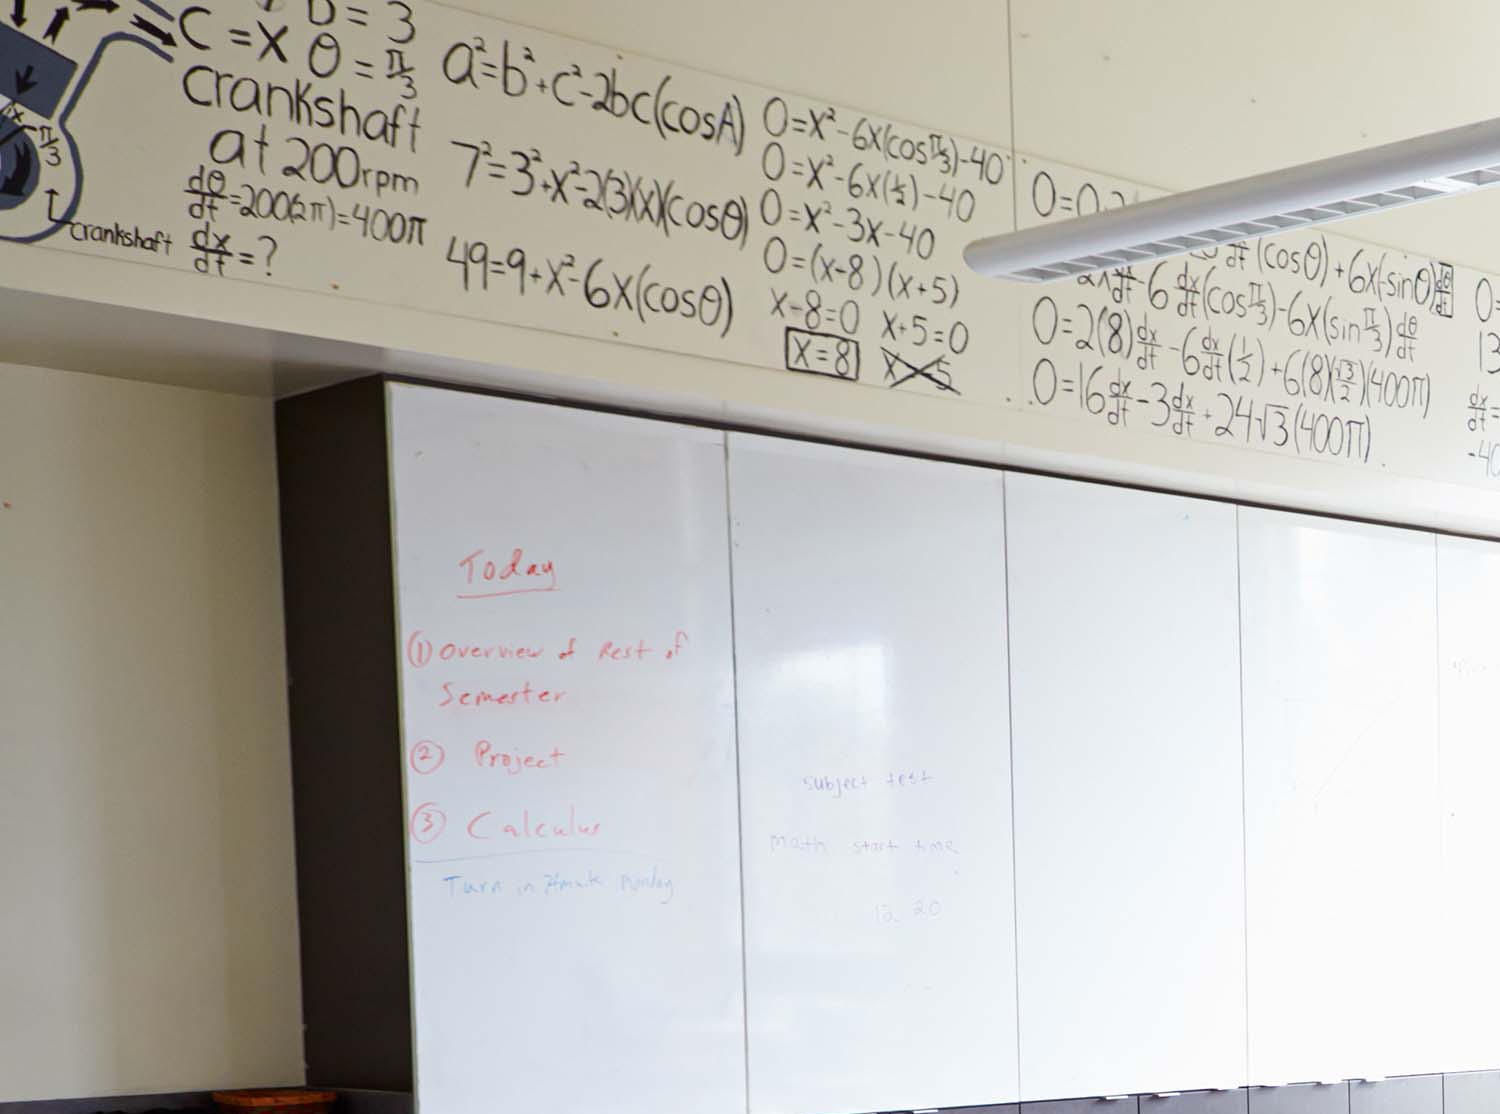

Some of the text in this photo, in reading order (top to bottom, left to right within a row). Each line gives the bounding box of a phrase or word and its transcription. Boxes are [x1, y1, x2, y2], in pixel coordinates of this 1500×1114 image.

[209, 124, 267, 175] at
[459, 548, 556, 590] Today
[439, 642, 544, 662] Overview
[559, 637, 577, 660] of
[598, 640, 655, 661] Rest
[665, 629, 690, 660] of
[439, 681, 568, 706] Semester
[474, 740, 566, 775] Project
[886, 769, 937, 785] test
[467, 803, 602, 840] Calculus
[442, 875, 502, 896] Turn
